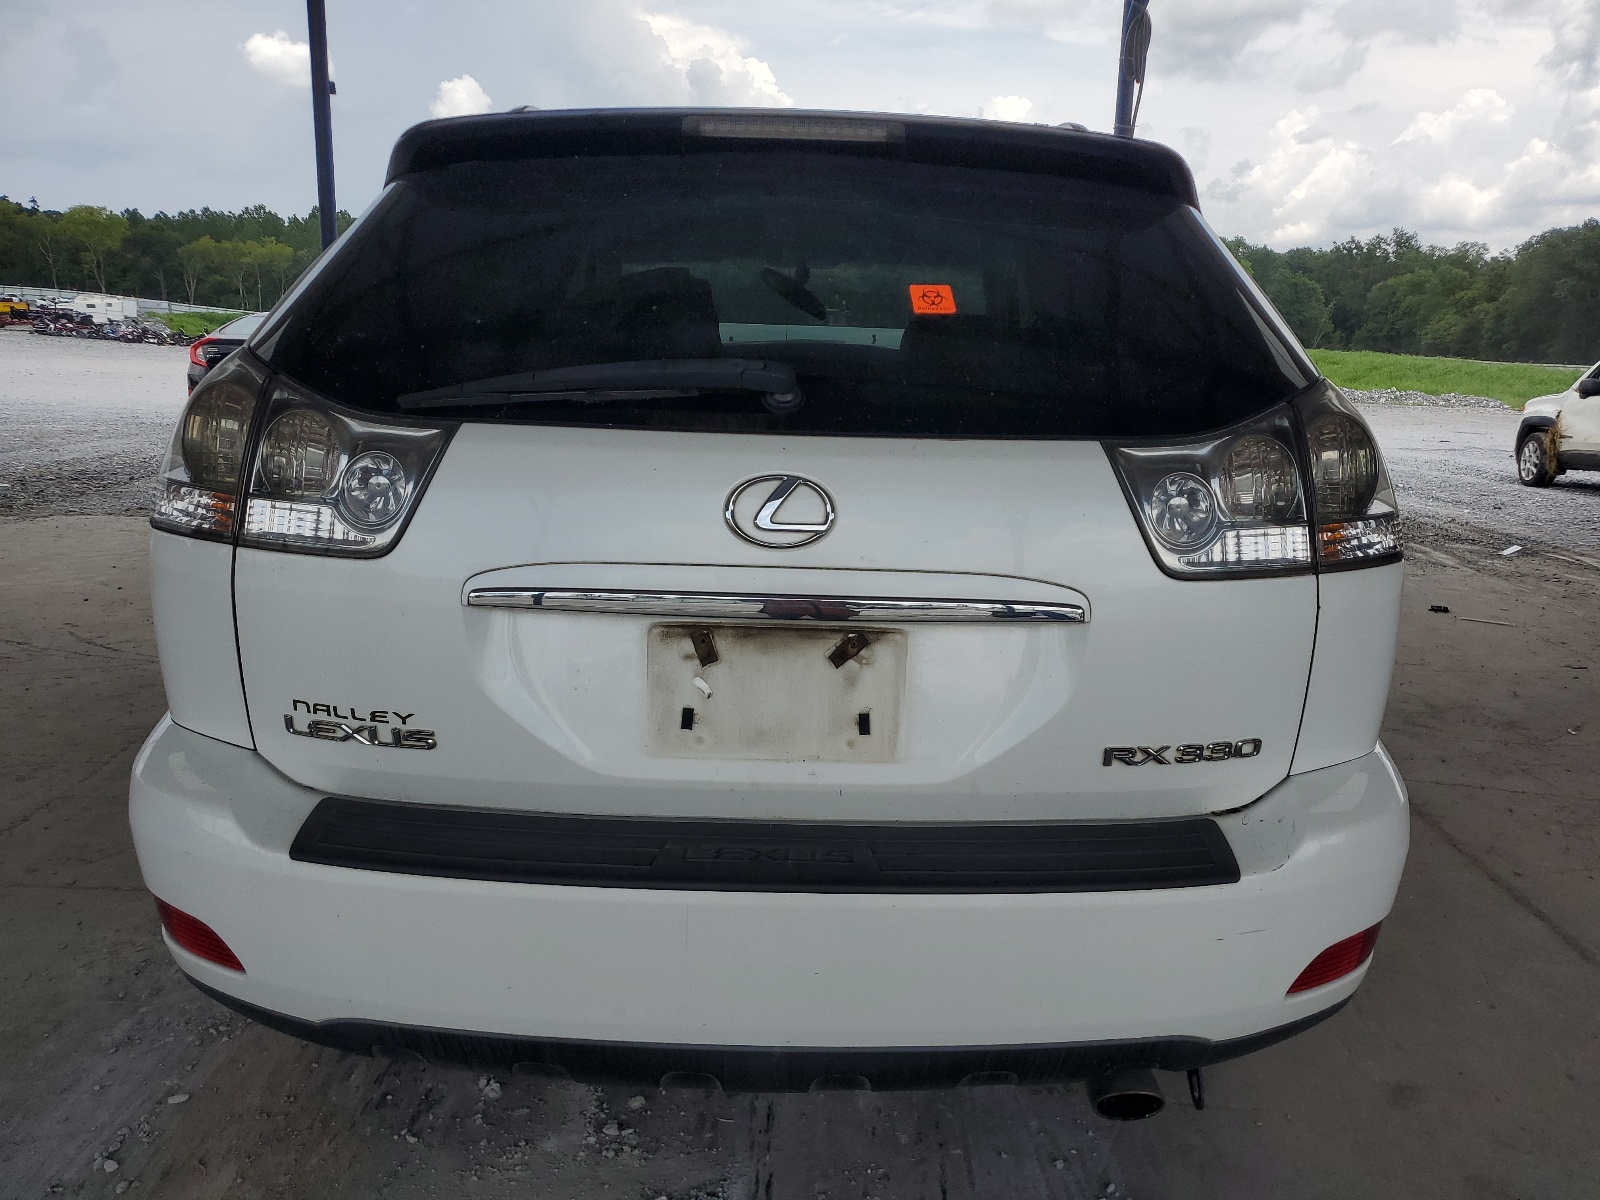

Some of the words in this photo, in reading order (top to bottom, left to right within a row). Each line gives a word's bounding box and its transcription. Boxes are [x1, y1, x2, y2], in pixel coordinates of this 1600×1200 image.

[292, 699, 415, 725] NALLEY
[283, 713, 437, 750] LEXUS
[1102, 744, 1172, 767] RX
[1174, 738, 1263, 763] 330
[682, 847, 855, 864] LEXUS
